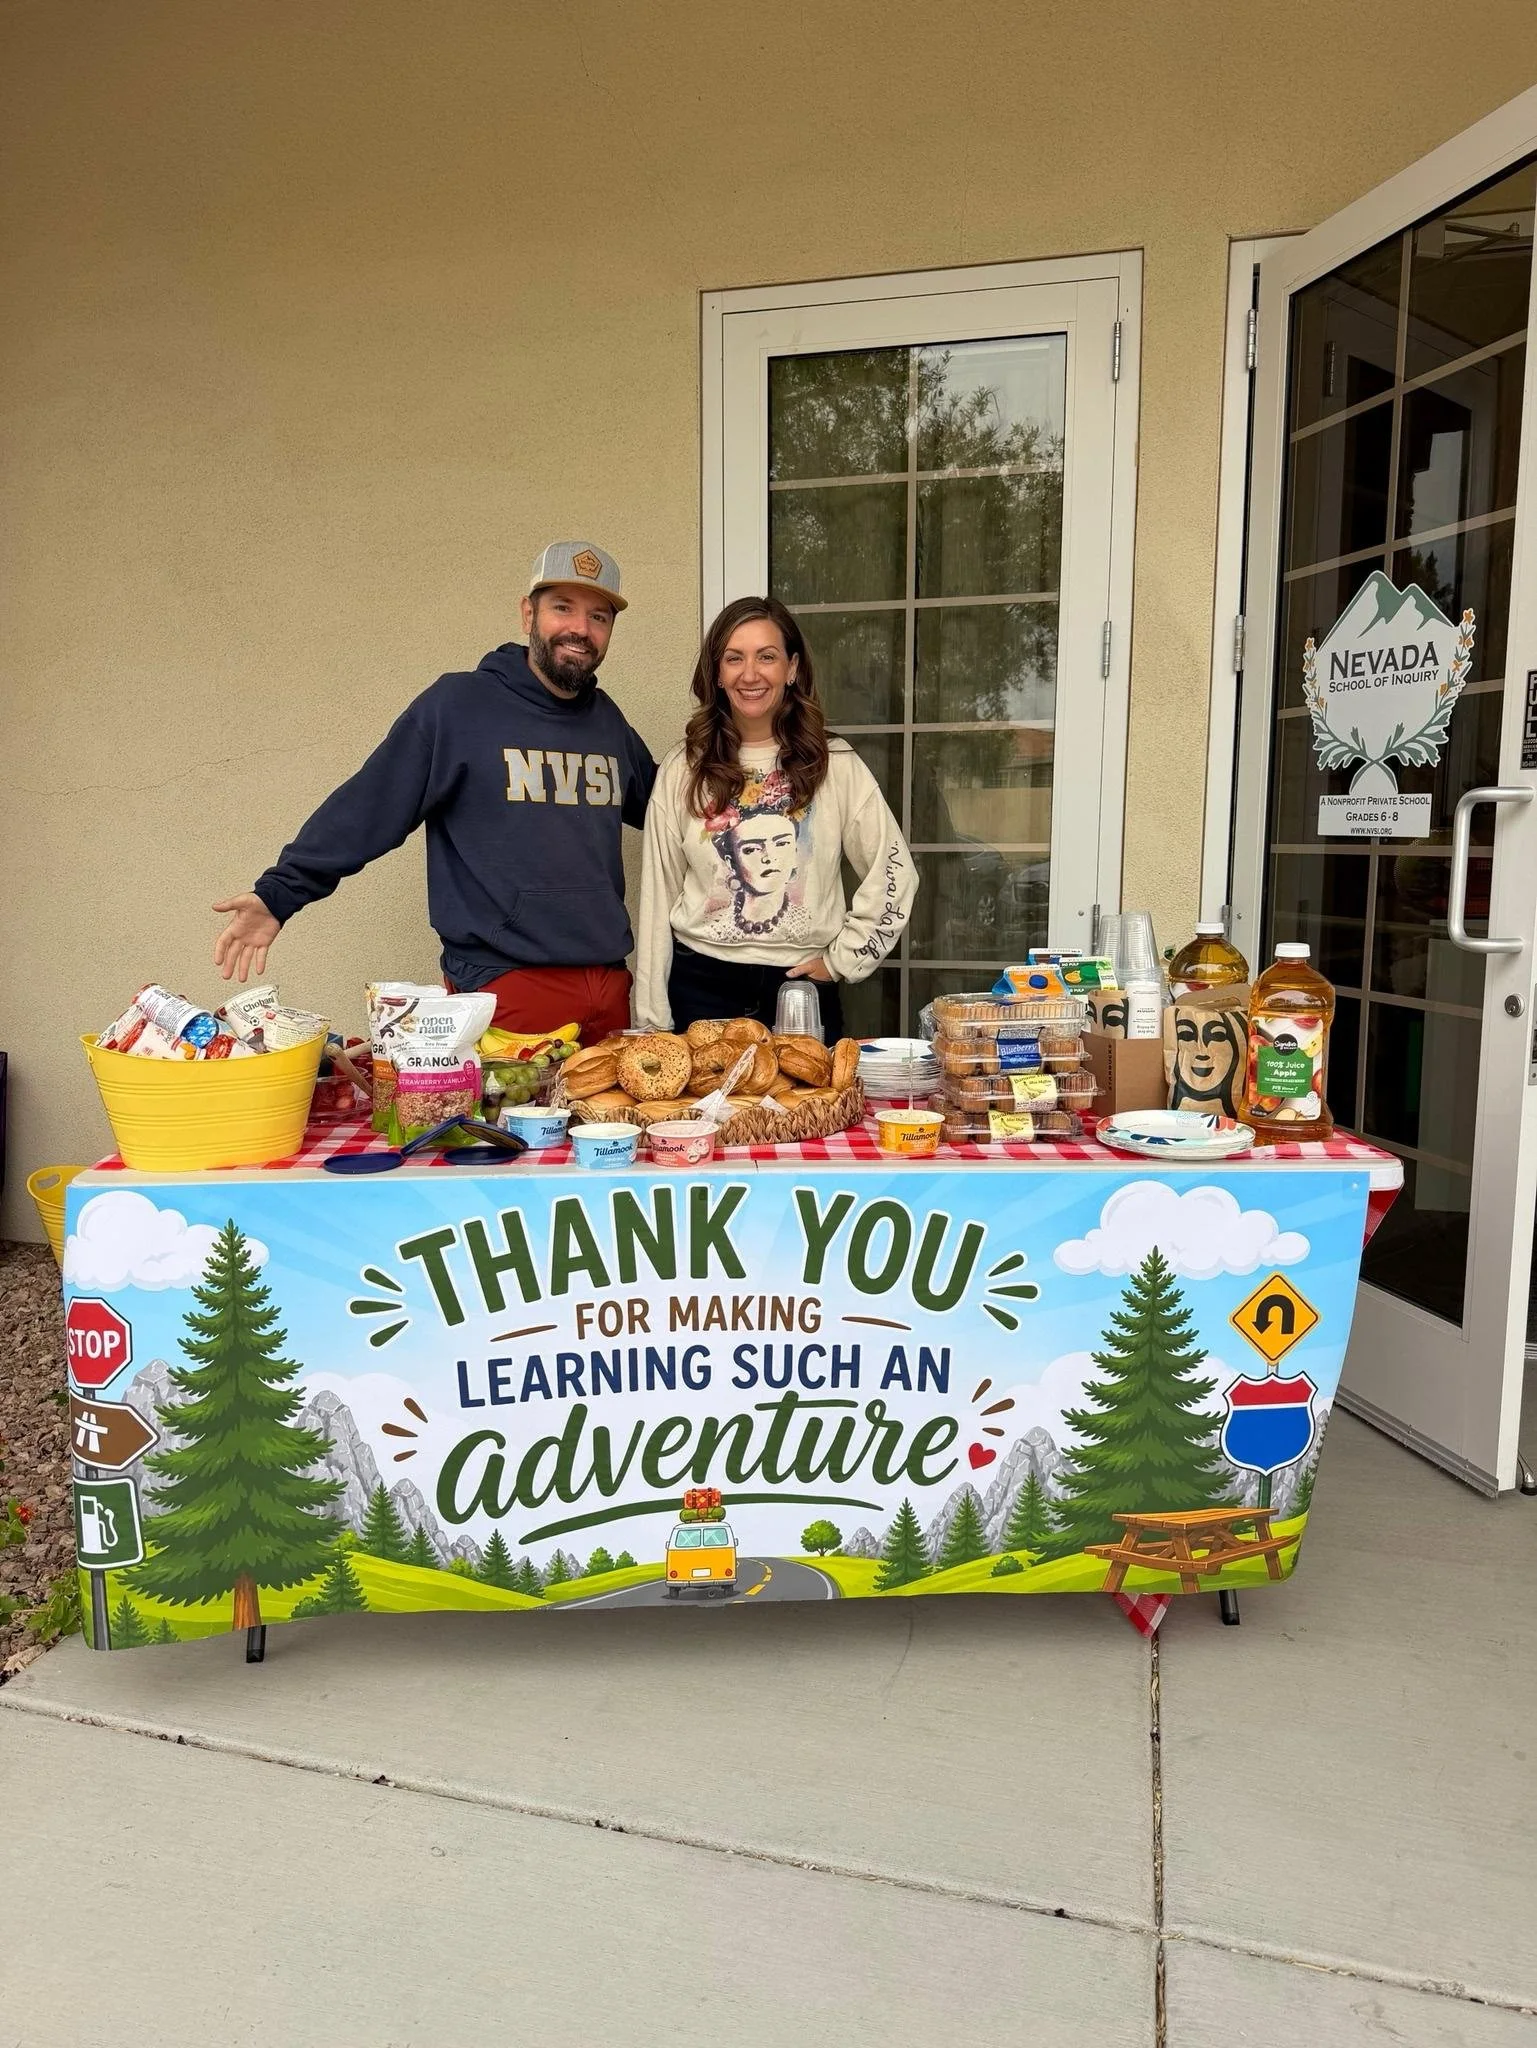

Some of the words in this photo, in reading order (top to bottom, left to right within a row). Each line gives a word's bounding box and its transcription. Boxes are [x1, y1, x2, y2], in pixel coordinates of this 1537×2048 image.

[1330, 641, 1439, 680] NEVADA
[1329, 679, 1371, 693] SCHOOL
[1374, 676, 1389, 687] OF
[1391, 669, 1439, 686] INQUIRY
[1320, 798, 1326, 806] A
[1327, 797, 1366, 806] NONPROFIT
[1367, 796, 1398, 806] PRIVATE
[1399, 795, 1431, 806] SCHOOL
[1345, 811, 1379, 822] GRADES
[242, 996, 275, 1013] Chobani
[421, 1017, 453, 1027] open
[419, 1024, 457, 1034] nature
[1000, 1043, 1037, 1056] Blueberry
[406, 1055, 460, 1067] GRANOLA
[1267, 1061, 1284, 1069] 100%
[1285, 1061, 1305, 1069] Juice
[1273, 1069, 1297, 1077] Apple
[900, 1131, 937, 1141] Tillamook
[593, 1144, 633, 1157] Tillamook
[399, 1186, 747, 1327] THANK
[793, 1189, 985, 1313] YOU
[576, 1300, 651, 1340] FOR
[669, 1295, 822, 1334] MAKING
[68, 1329, 121, 1359] STOP
[456, 1346, 712, 1408] LEARNING
[732, 1343, 860, 1392] SUCH
[880, 1344, 951, 1394] AN
[436, 1390, 960, 1524] adventure
